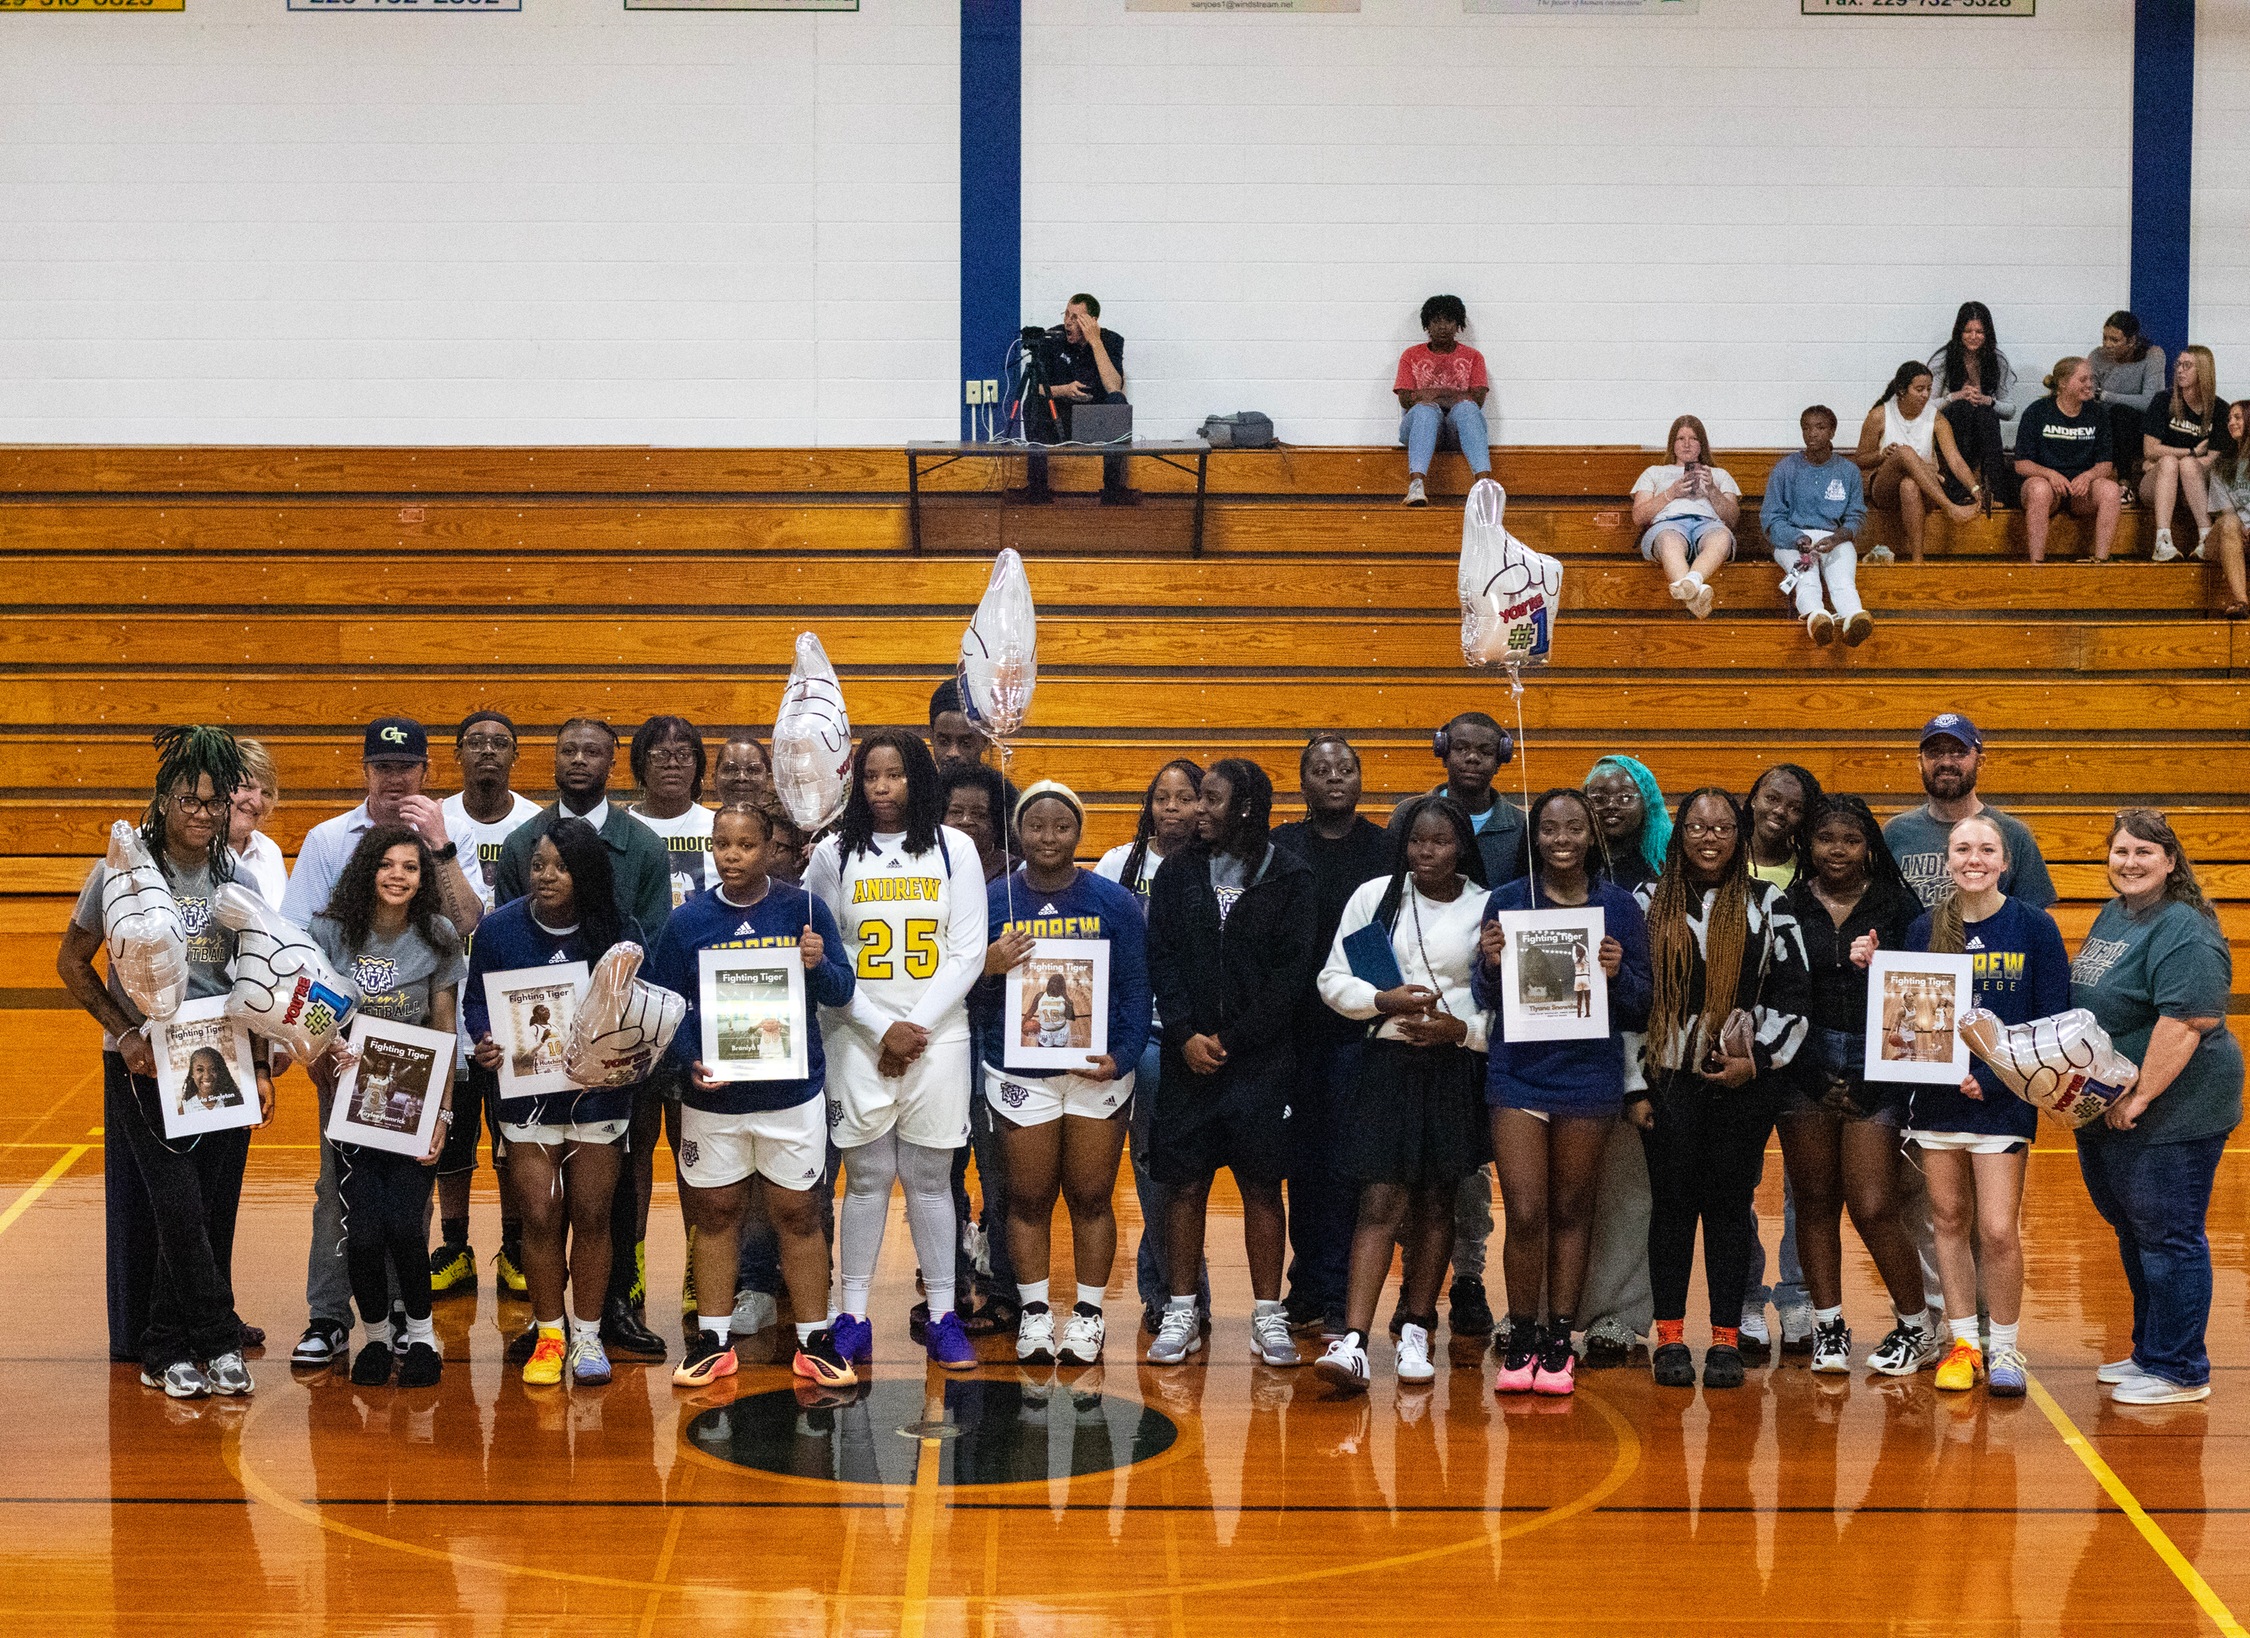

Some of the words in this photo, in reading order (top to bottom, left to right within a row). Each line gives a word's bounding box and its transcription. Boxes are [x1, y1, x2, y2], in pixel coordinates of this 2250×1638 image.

[2042, 424, 2096, 436] ANDREW
[1507, 607, 1550, 656] #1
[380, 726, 408, 745] GT
[852, 877, 941, 905] ANDREW
[1522, 934, 1559, 944] Fighting
[1560, 932, 1583, 942] Tiger
[856, 918, 940, 980] 25
[1029, 962, 1064, 972] Fighting
[1065, 963, 1088, 972] Tiger
[722, 973, 759, 984] Fighting
[760, 972, 783, 983] Tiger
[1890, 975, 1926, 987] Fighting
[1927, 977, 1951, 987] Tiger
[282, 976, 311, 1026] YOU'RE
[508, 992, 545, 1004] Fighting
[546, 989, 569, 999] Tiger
[304, 979, 354, 1036] #1
[170, 1028, 204, 1040] Fighting
[205, 1025, 226, 1035] Tiger
[370, 1040, 406, 1057] Fighting
[406, 1047, 430, 1060] Tiger
